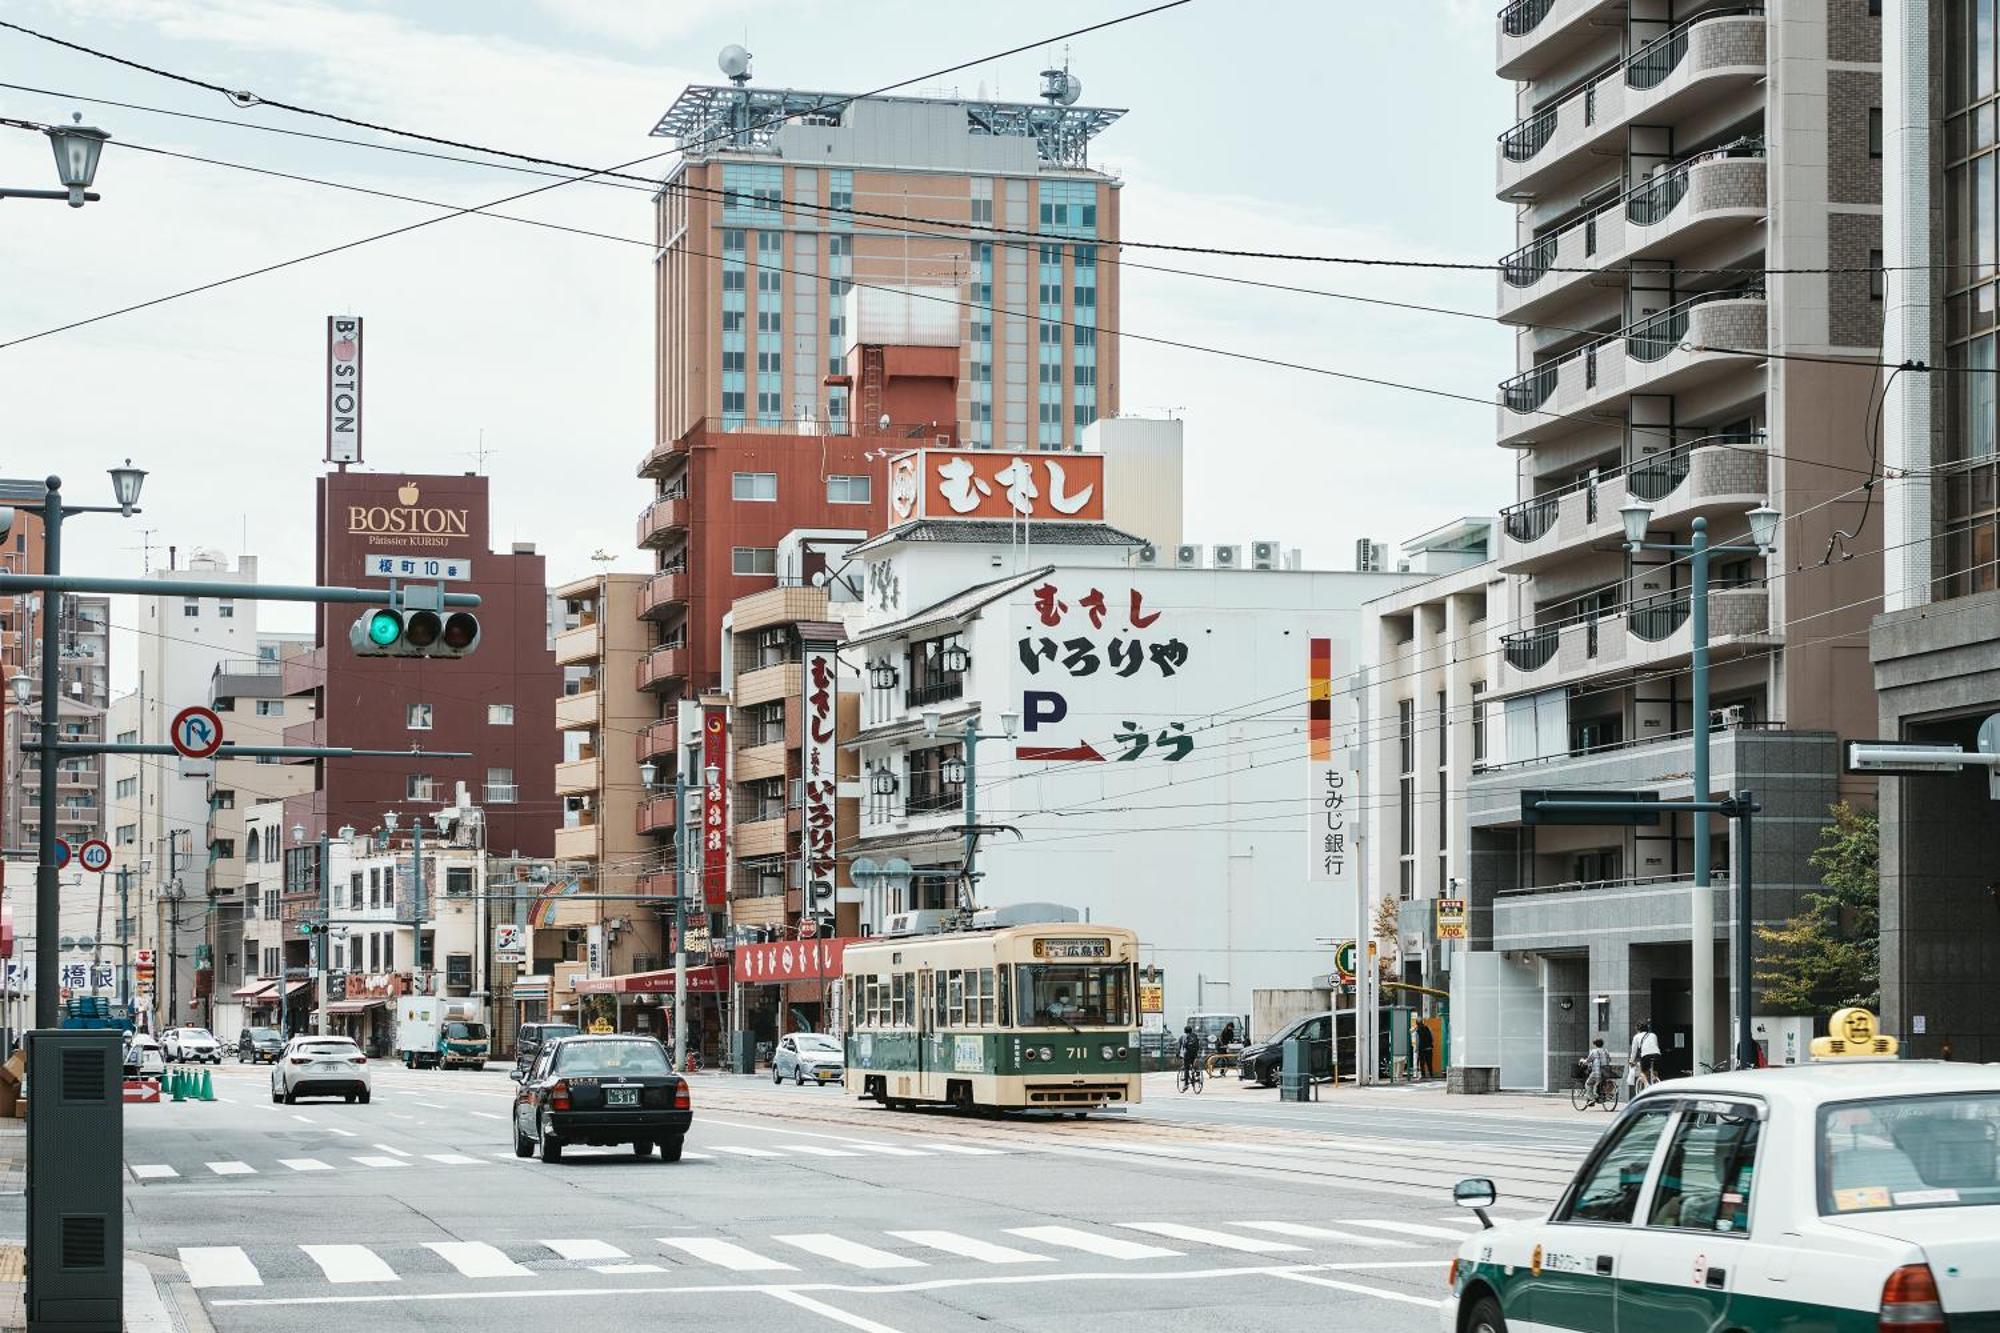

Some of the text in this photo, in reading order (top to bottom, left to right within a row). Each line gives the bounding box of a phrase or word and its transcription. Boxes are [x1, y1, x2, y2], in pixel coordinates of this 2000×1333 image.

[938, 457, 1094, 514] むさし
[348, 506, 469, 533] BOSTON
[368, 536, 449, 546] Pâtissier KURISU
[1034, 583, 1161, 630] むさし
[1018, 637, 1188, 678] いろりや
[809, 656, 835, 744] むさし
[1024, 690, 1068, 732] P
[1113, 721, 1194, 762] うら
[807, 780, 834, 878] いろりや
[1325, 769, 1344, 875] もみじ銀行
[87, 849, 105, 863] 40
[809, 881, 832, 908] P
[1035, 942, 1042, 955] 6
[1066, 1048, 1087, 1059] 711
